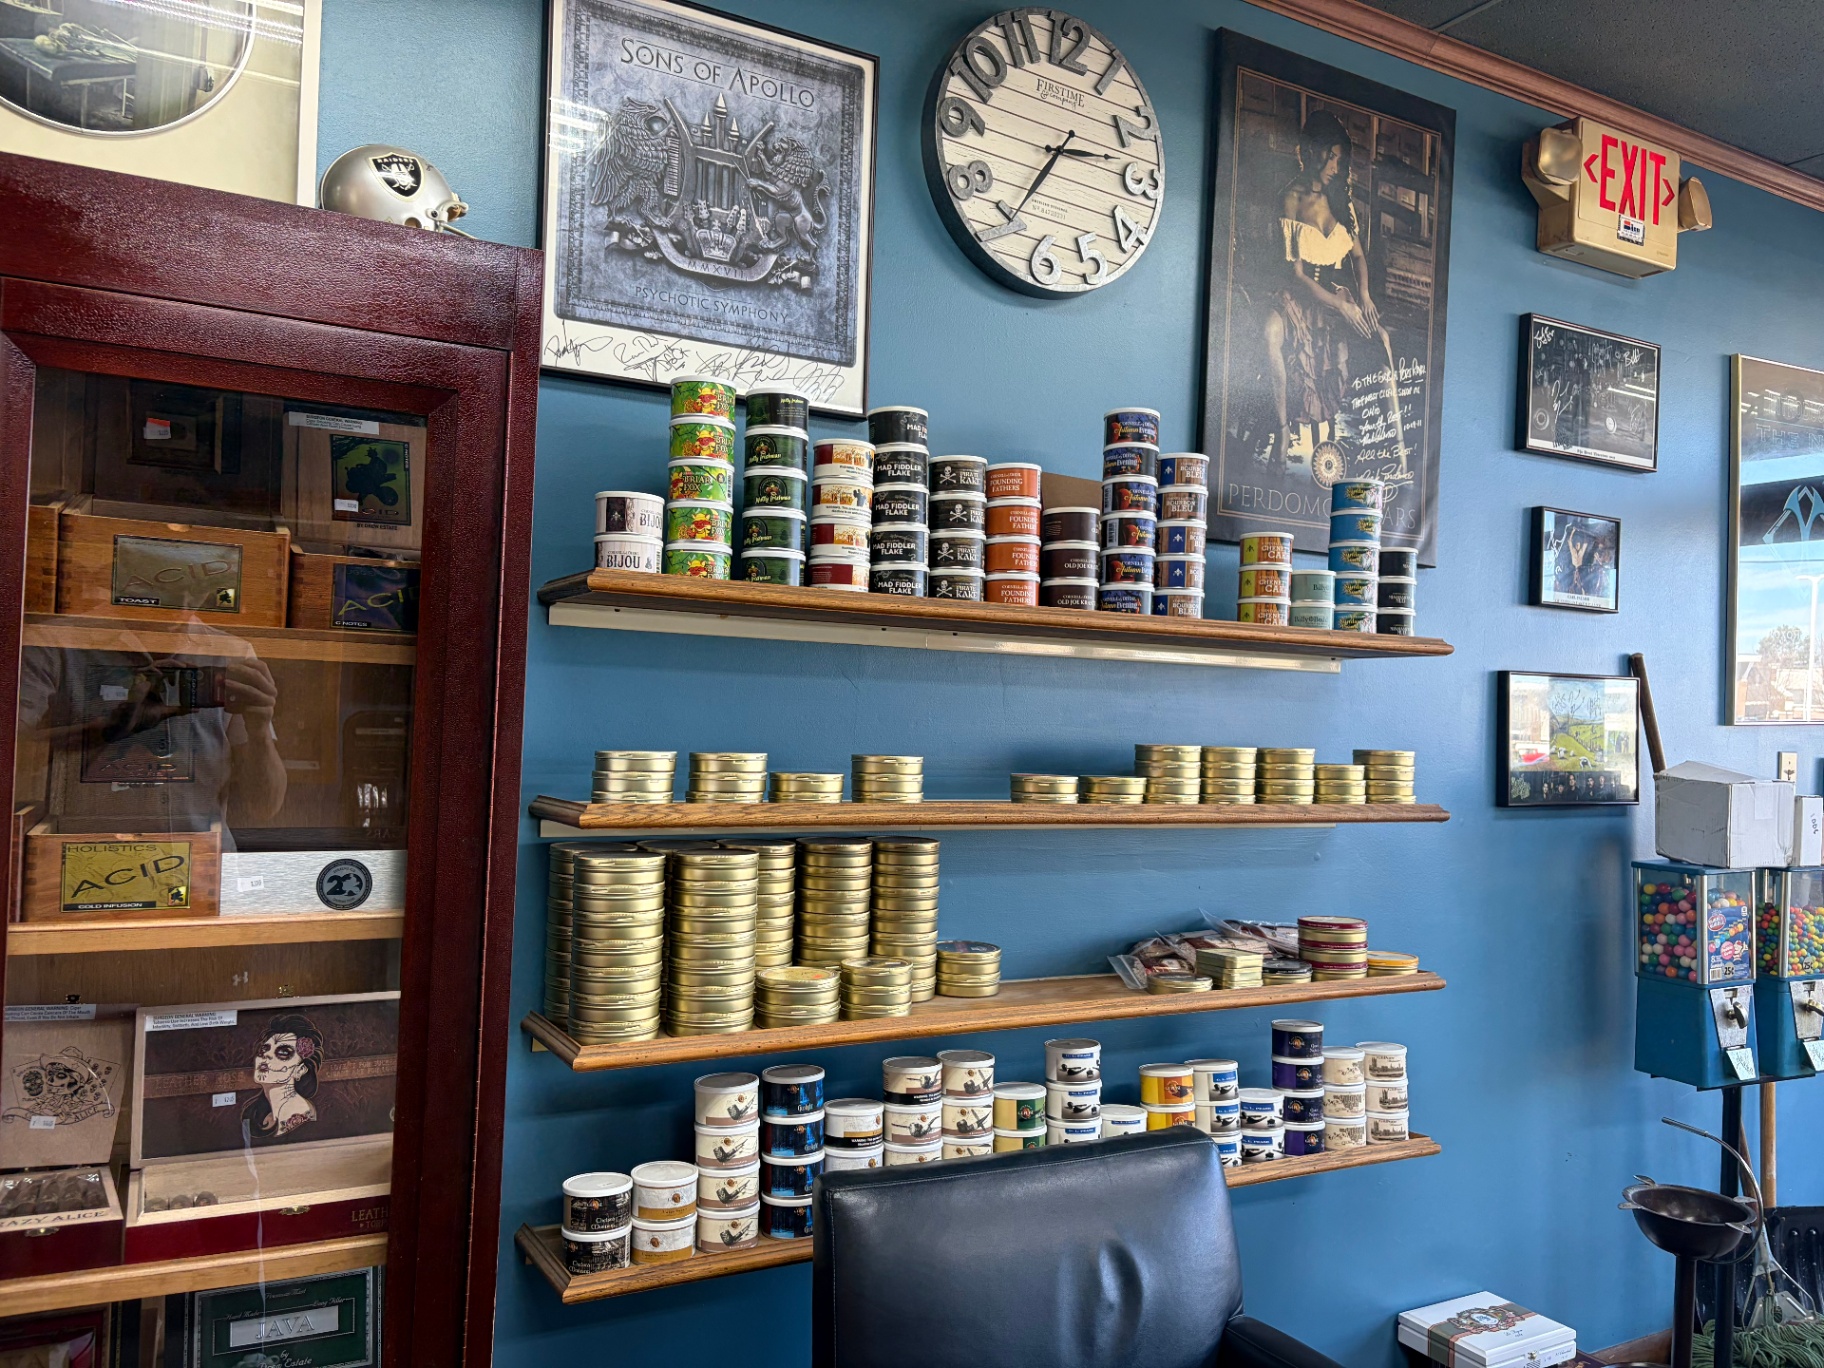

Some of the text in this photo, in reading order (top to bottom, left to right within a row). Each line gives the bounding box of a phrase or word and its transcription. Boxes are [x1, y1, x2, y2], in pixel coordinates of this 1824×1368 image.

[995, 9, 1041, 69] 11
[1048, 10, 1092, 76] 12
[621, 37, 815, 109] SONS OF APOLLO
[949, 36, 1007, 104] 10
[1095, 48, 1126, 96] 1
[1036, 79, 1085, 108] FIRSTIME
[940, 97, 986, 138] 9
[1112, 105, 1157, 149] 2
[948, 160, 994, 200] 8
[1124, 162, 1162, 200] 3
[1600, 134, 1666, 226] EXIT
[974, 200, 1027, 243] 7
[1112, 205, 1150, 253] 4
[1029, 235, 1062, 285] 6
[1076, 232, 1108, 285] 5
[636, 286, 789, 325] PSYCHOTIC SYMPHONY
[877, 463, 922, 472] MAD FIDDLER
[887, 469, 911, 477] FLAKE
[989, 478, 1023, 486] FOUNDING
[992, 485, 1020, 493] FATHERS
[876, 503, 920, 511] MAD FIDDLER
[881, 548, 904, 556] FLAKE
[886, 542, 916, 550] FIDDLER
[122, 560, 232, 592] ACID
[607, 554, 640, 569] BIJOU
[119, 597, 158, 605] TOAST
[888, 587, 912, 595] FLAKE
[67, 844, 158, 853] HOLISTICS
[70, 855, 185, 899] ACID
[74, 1106, 99, 1122] ALICE
[51, 1209, 106, 1223] ALICE
[255, 1314, 316, 1341] JAVA
[280, 1350, 290, 1361] by
[284, 1356, 313, 1368] Estate
